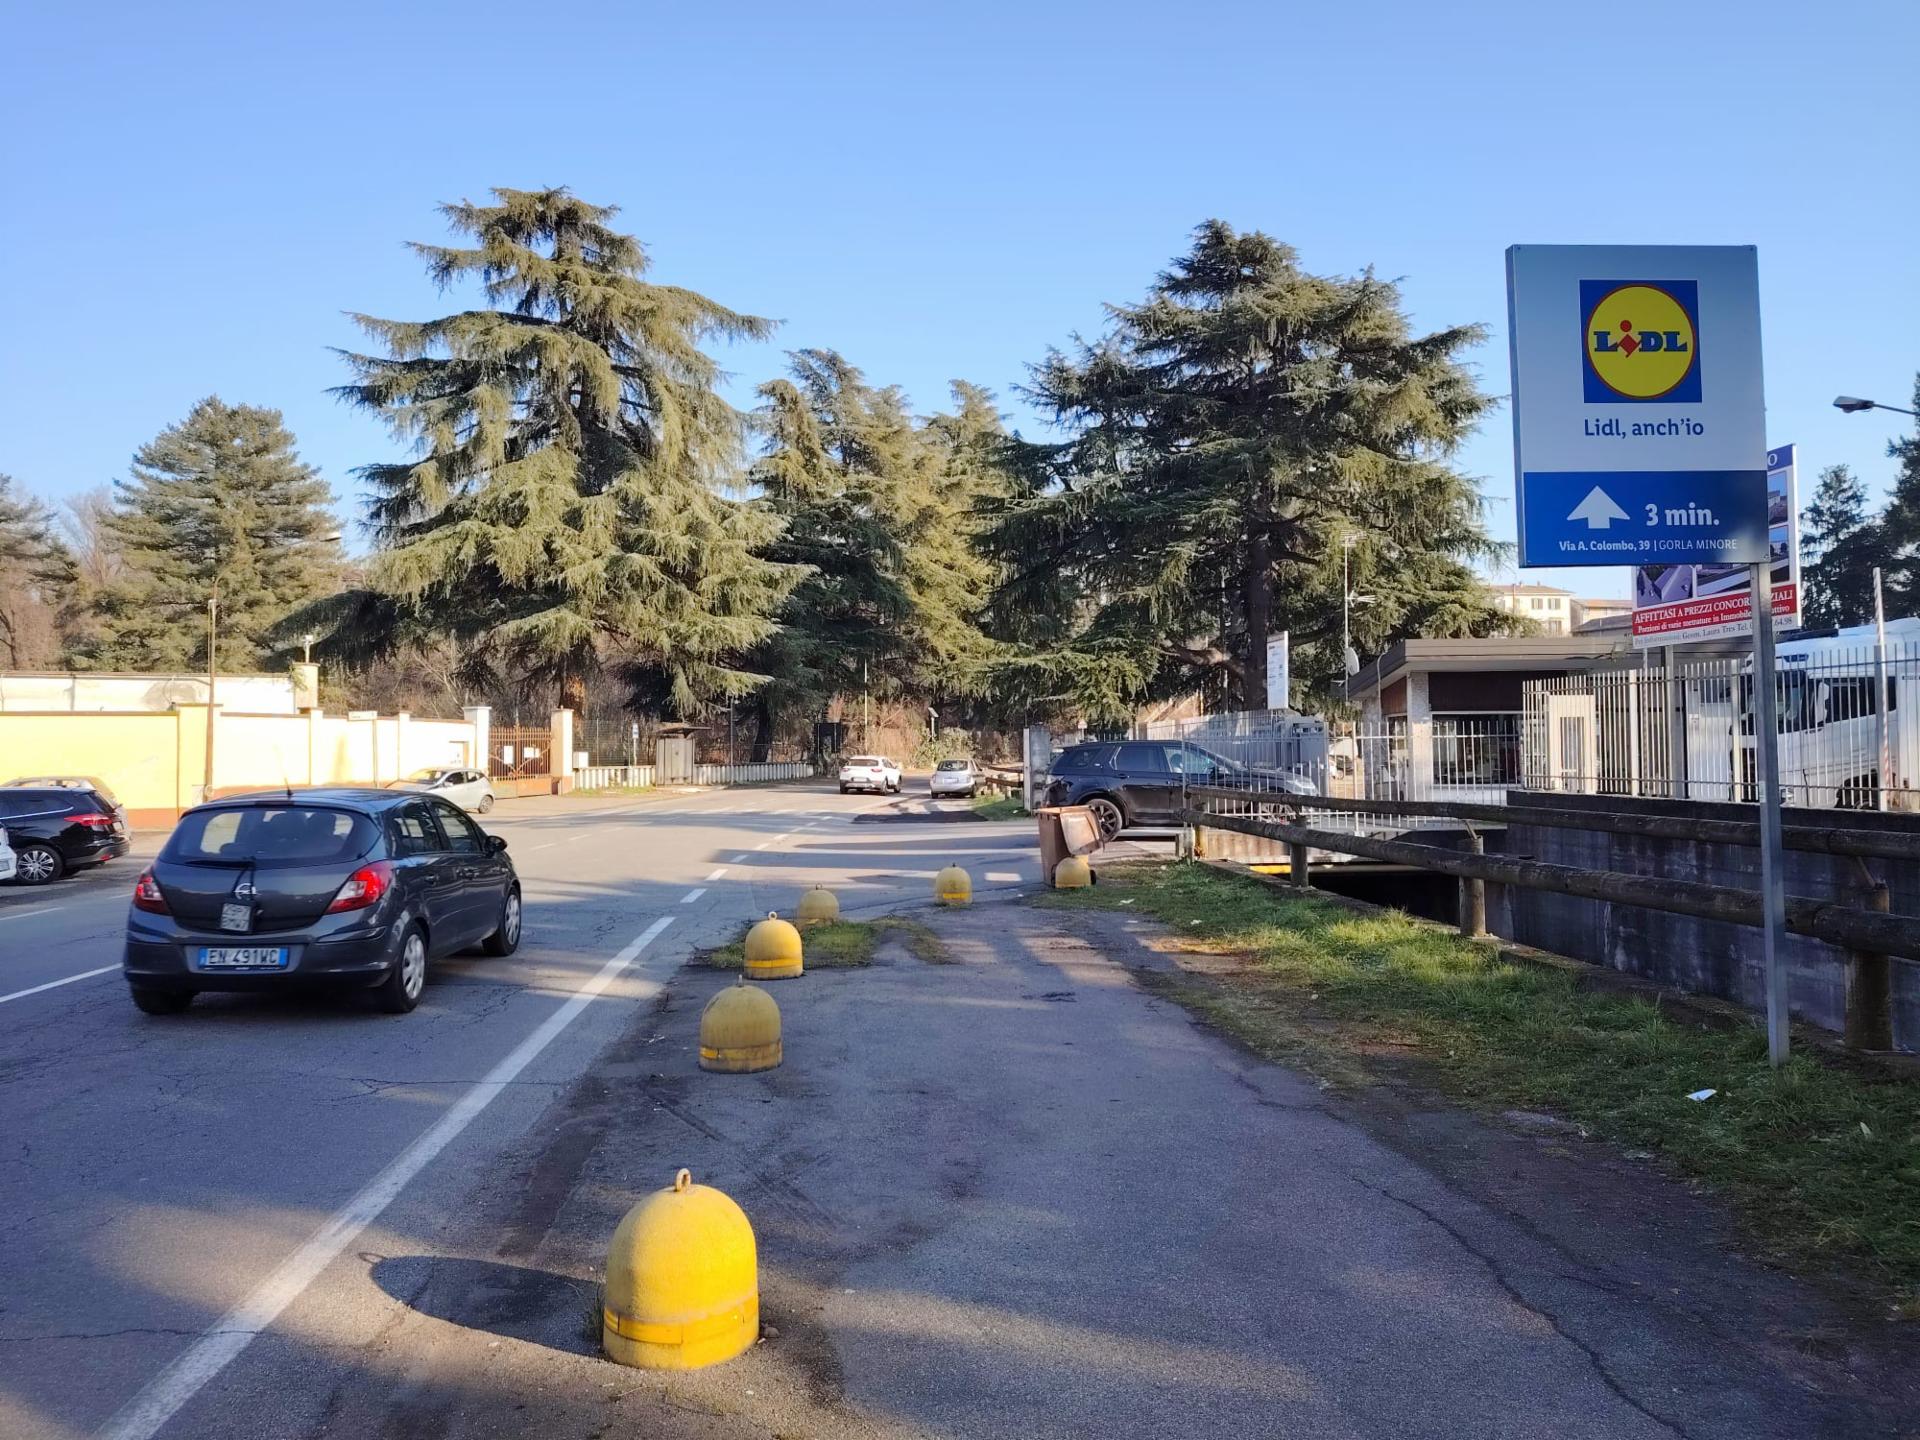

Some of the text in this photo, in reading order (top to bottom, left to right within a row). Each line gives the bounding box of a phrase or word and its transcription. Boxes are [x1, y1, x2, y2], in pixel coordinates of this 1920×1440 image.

[1584, 418, 1704, 439] Lidl, anch'io
[1645, 502, 1720, 526] 3 min.
[1559, 540, 1576, 551] Via
[1577, 541, 1589, 551] A.
[1590, 540, 1637, 552] Colombo,
[1638, 540, 1650, 550] 39
[1658, 540, 1693, 550] GORLA
[1696, 539, 1737, 550] MINORE
[1634, 608, 1677, 624] AFFITTASI
[1684, 602, 1713, 616] PREZZI
